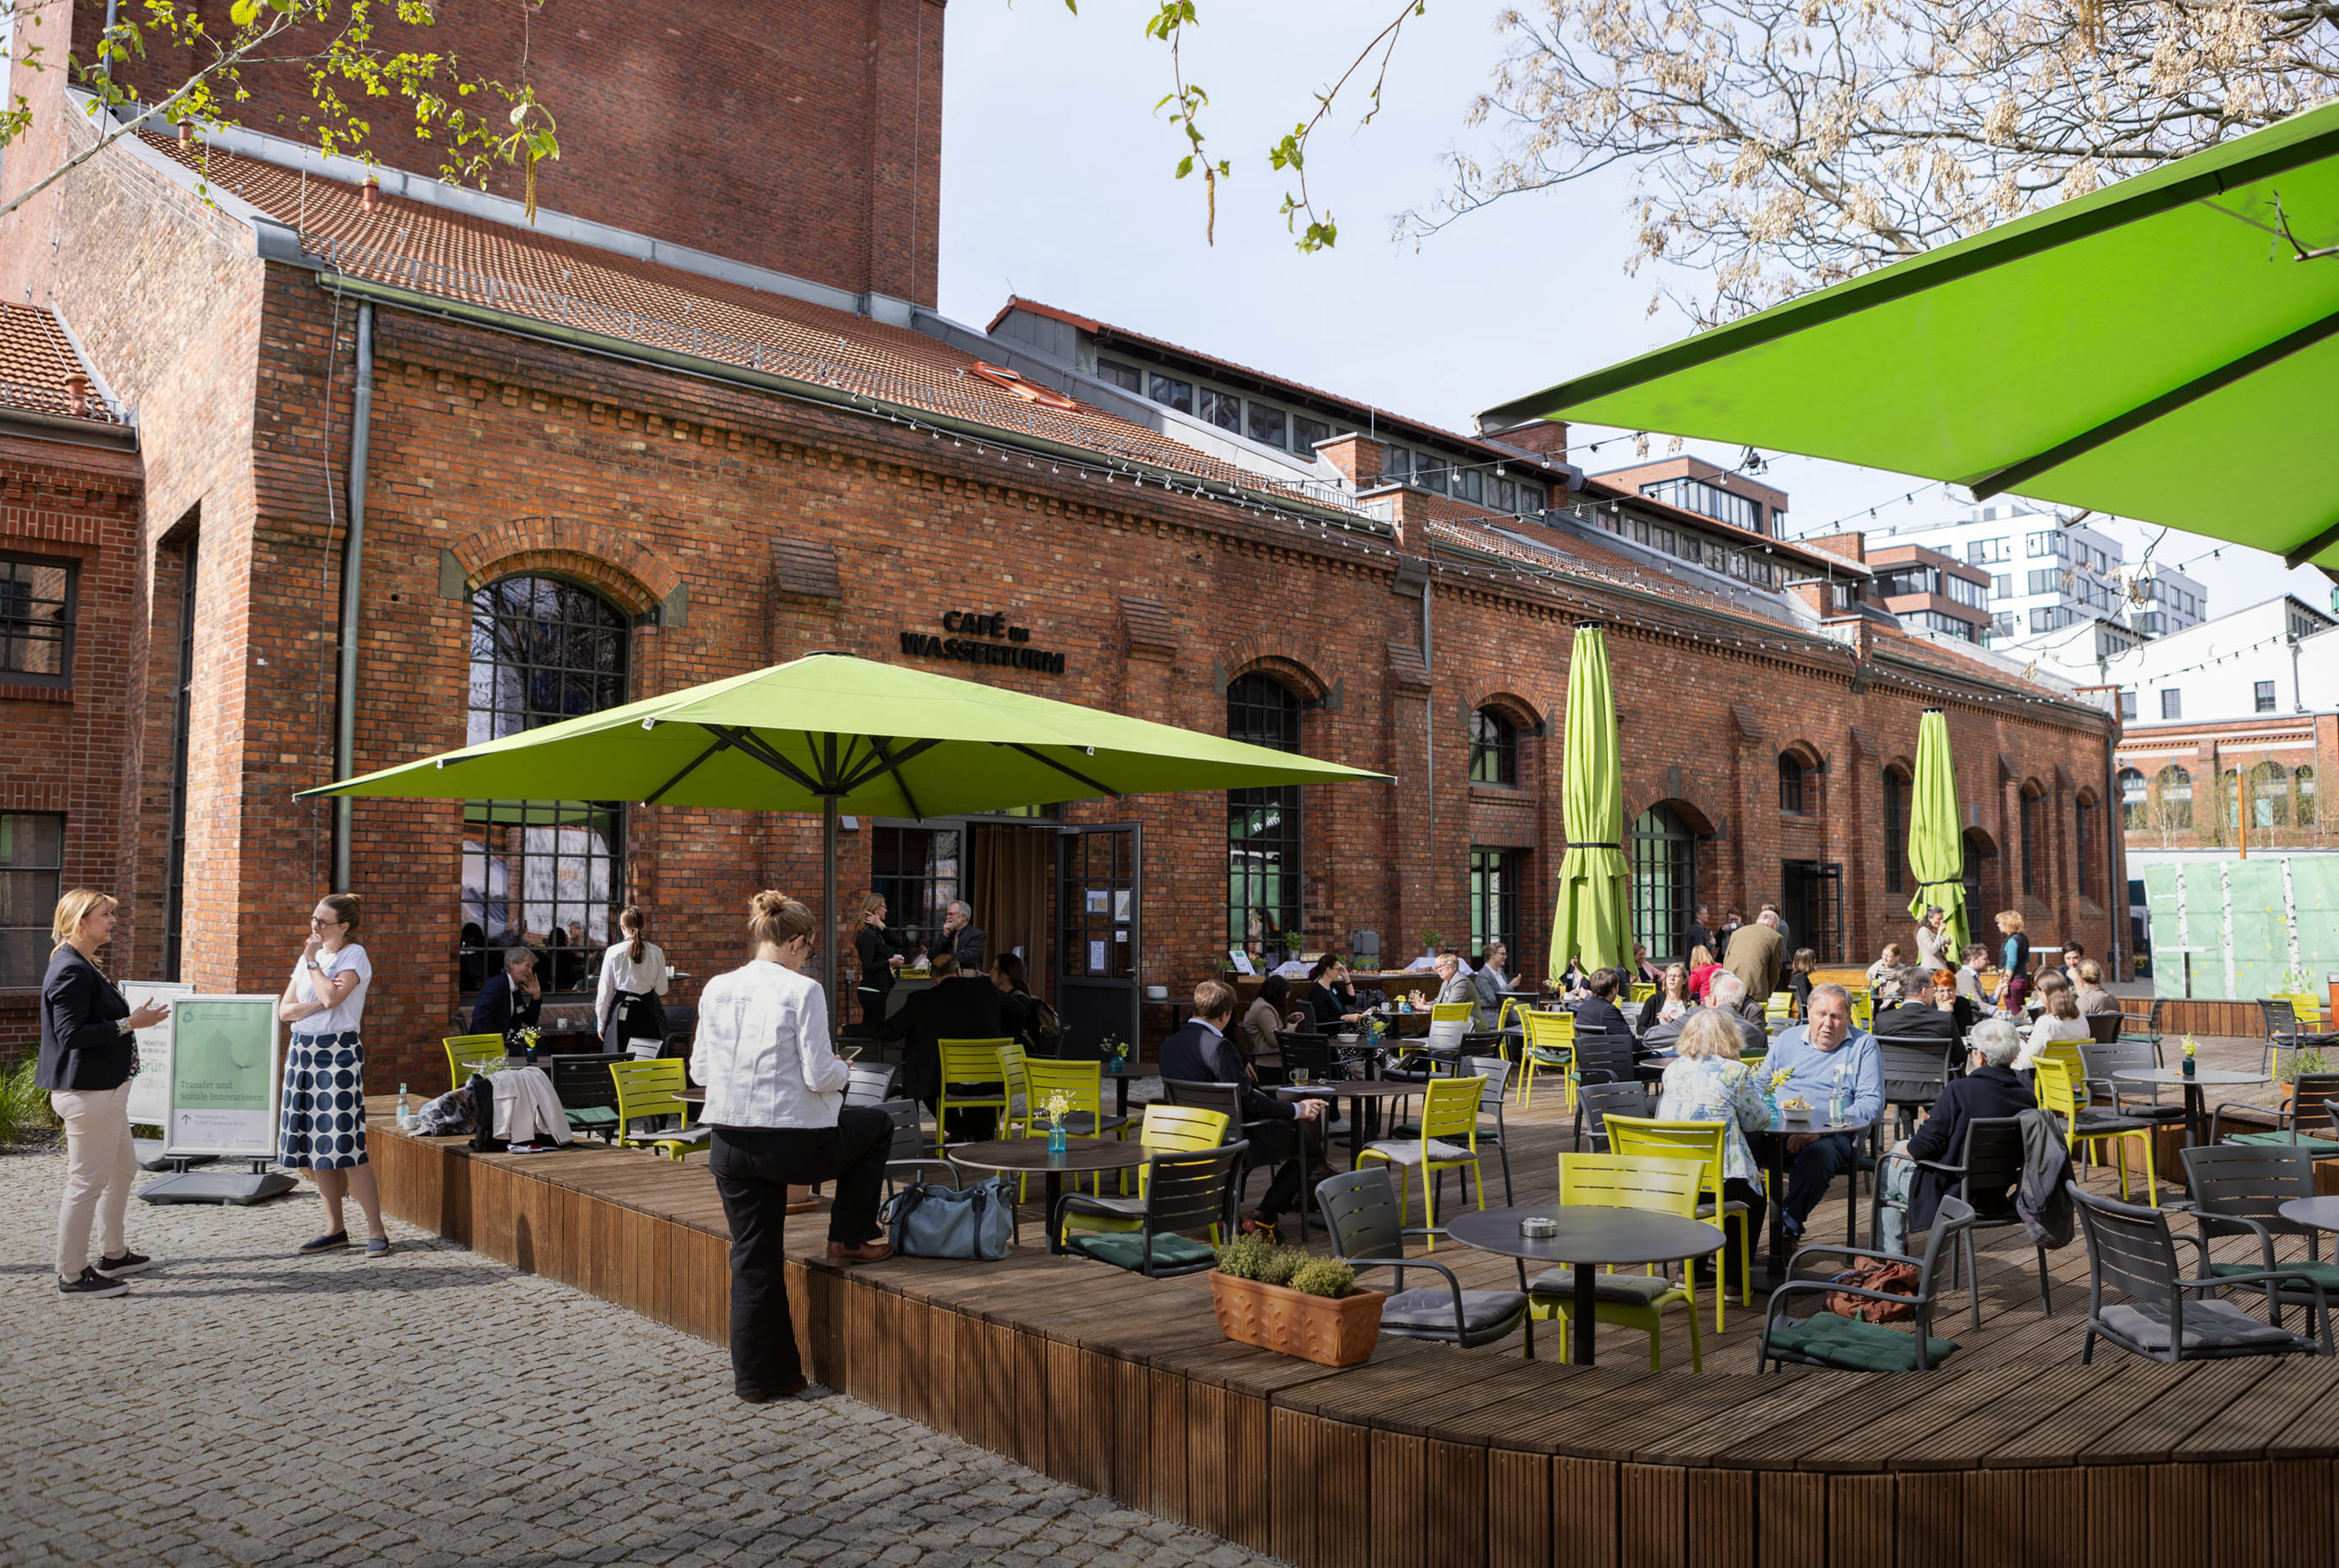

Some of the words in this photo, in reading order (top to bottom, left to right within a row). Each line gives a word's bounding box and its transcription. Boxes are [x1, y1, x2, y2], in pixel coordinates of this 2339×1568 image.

[943, 611, 1005, 639] CAFÉ
[1009, 626, 1030, 642] IM
[900, 631, 1065, 674] WASSERTURM
[181, 1080, 213, 1090] Transfer
[216, 1080, 233, 1090] und
[180, 1092, 208, 1101] Soziale
[210, 1093, 264, 1102] Innovationen
